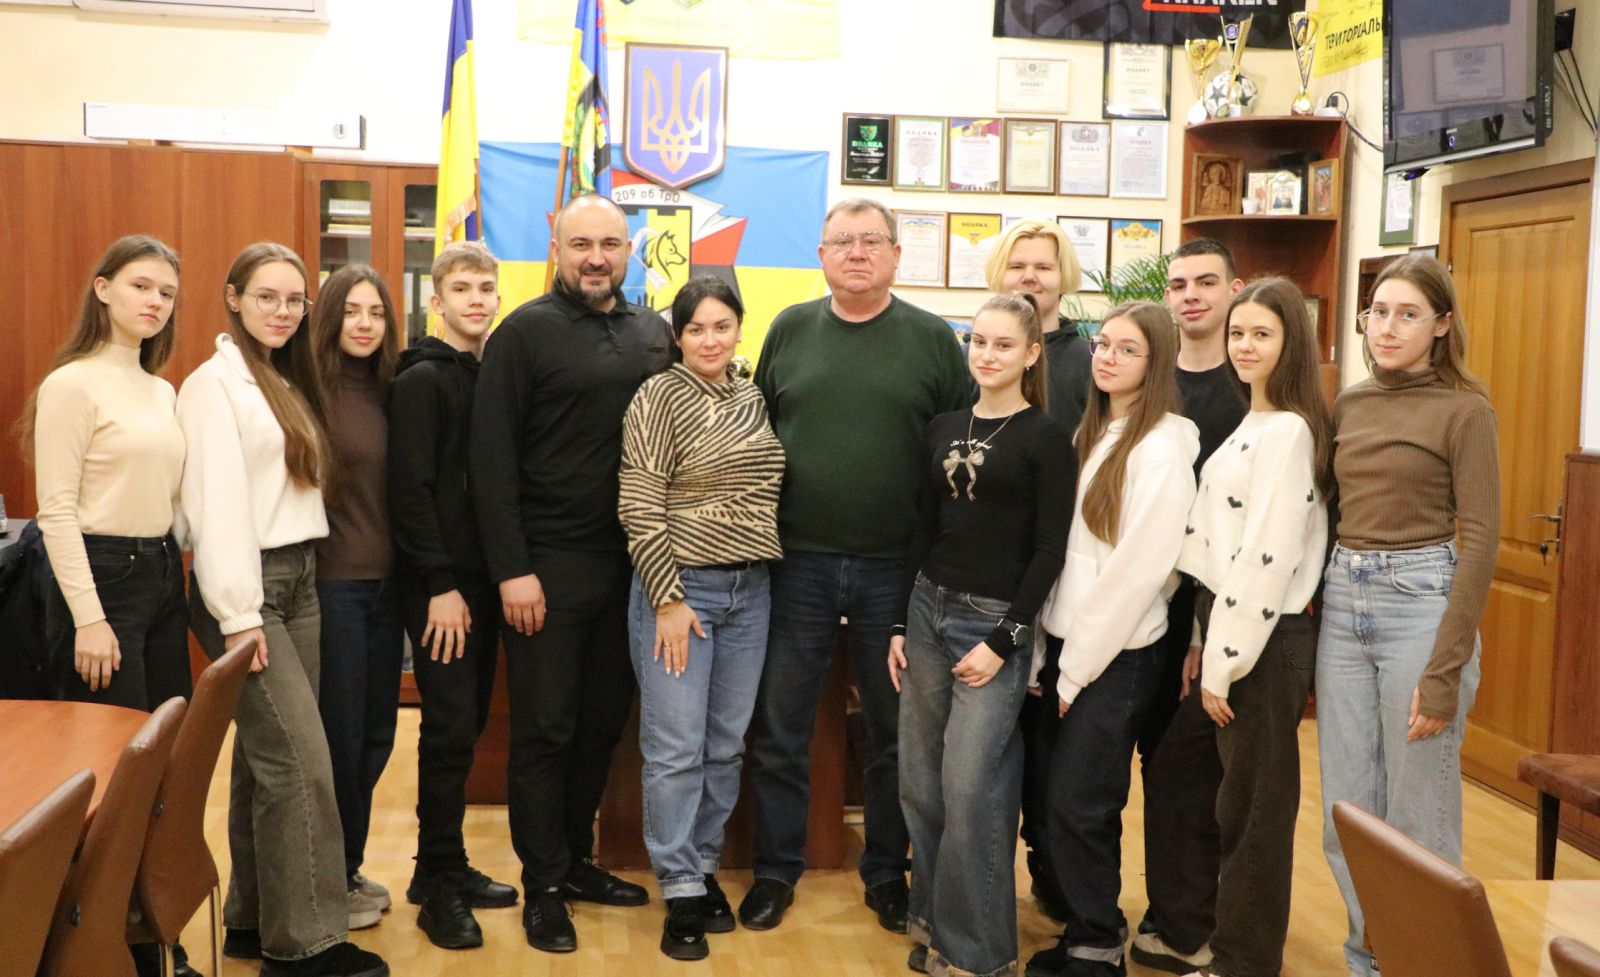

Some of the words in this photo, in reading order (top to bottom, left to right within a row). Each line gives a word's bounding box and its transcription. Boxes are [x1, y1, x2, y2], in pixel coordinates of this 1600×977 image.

[1325, 17, 1383, 50] ТЕРИТОРІАЛЬ
[615, 189, 636, 201] 209
[641, 189, 655, 198] об
[660, 190, 680, 203] ТрО
